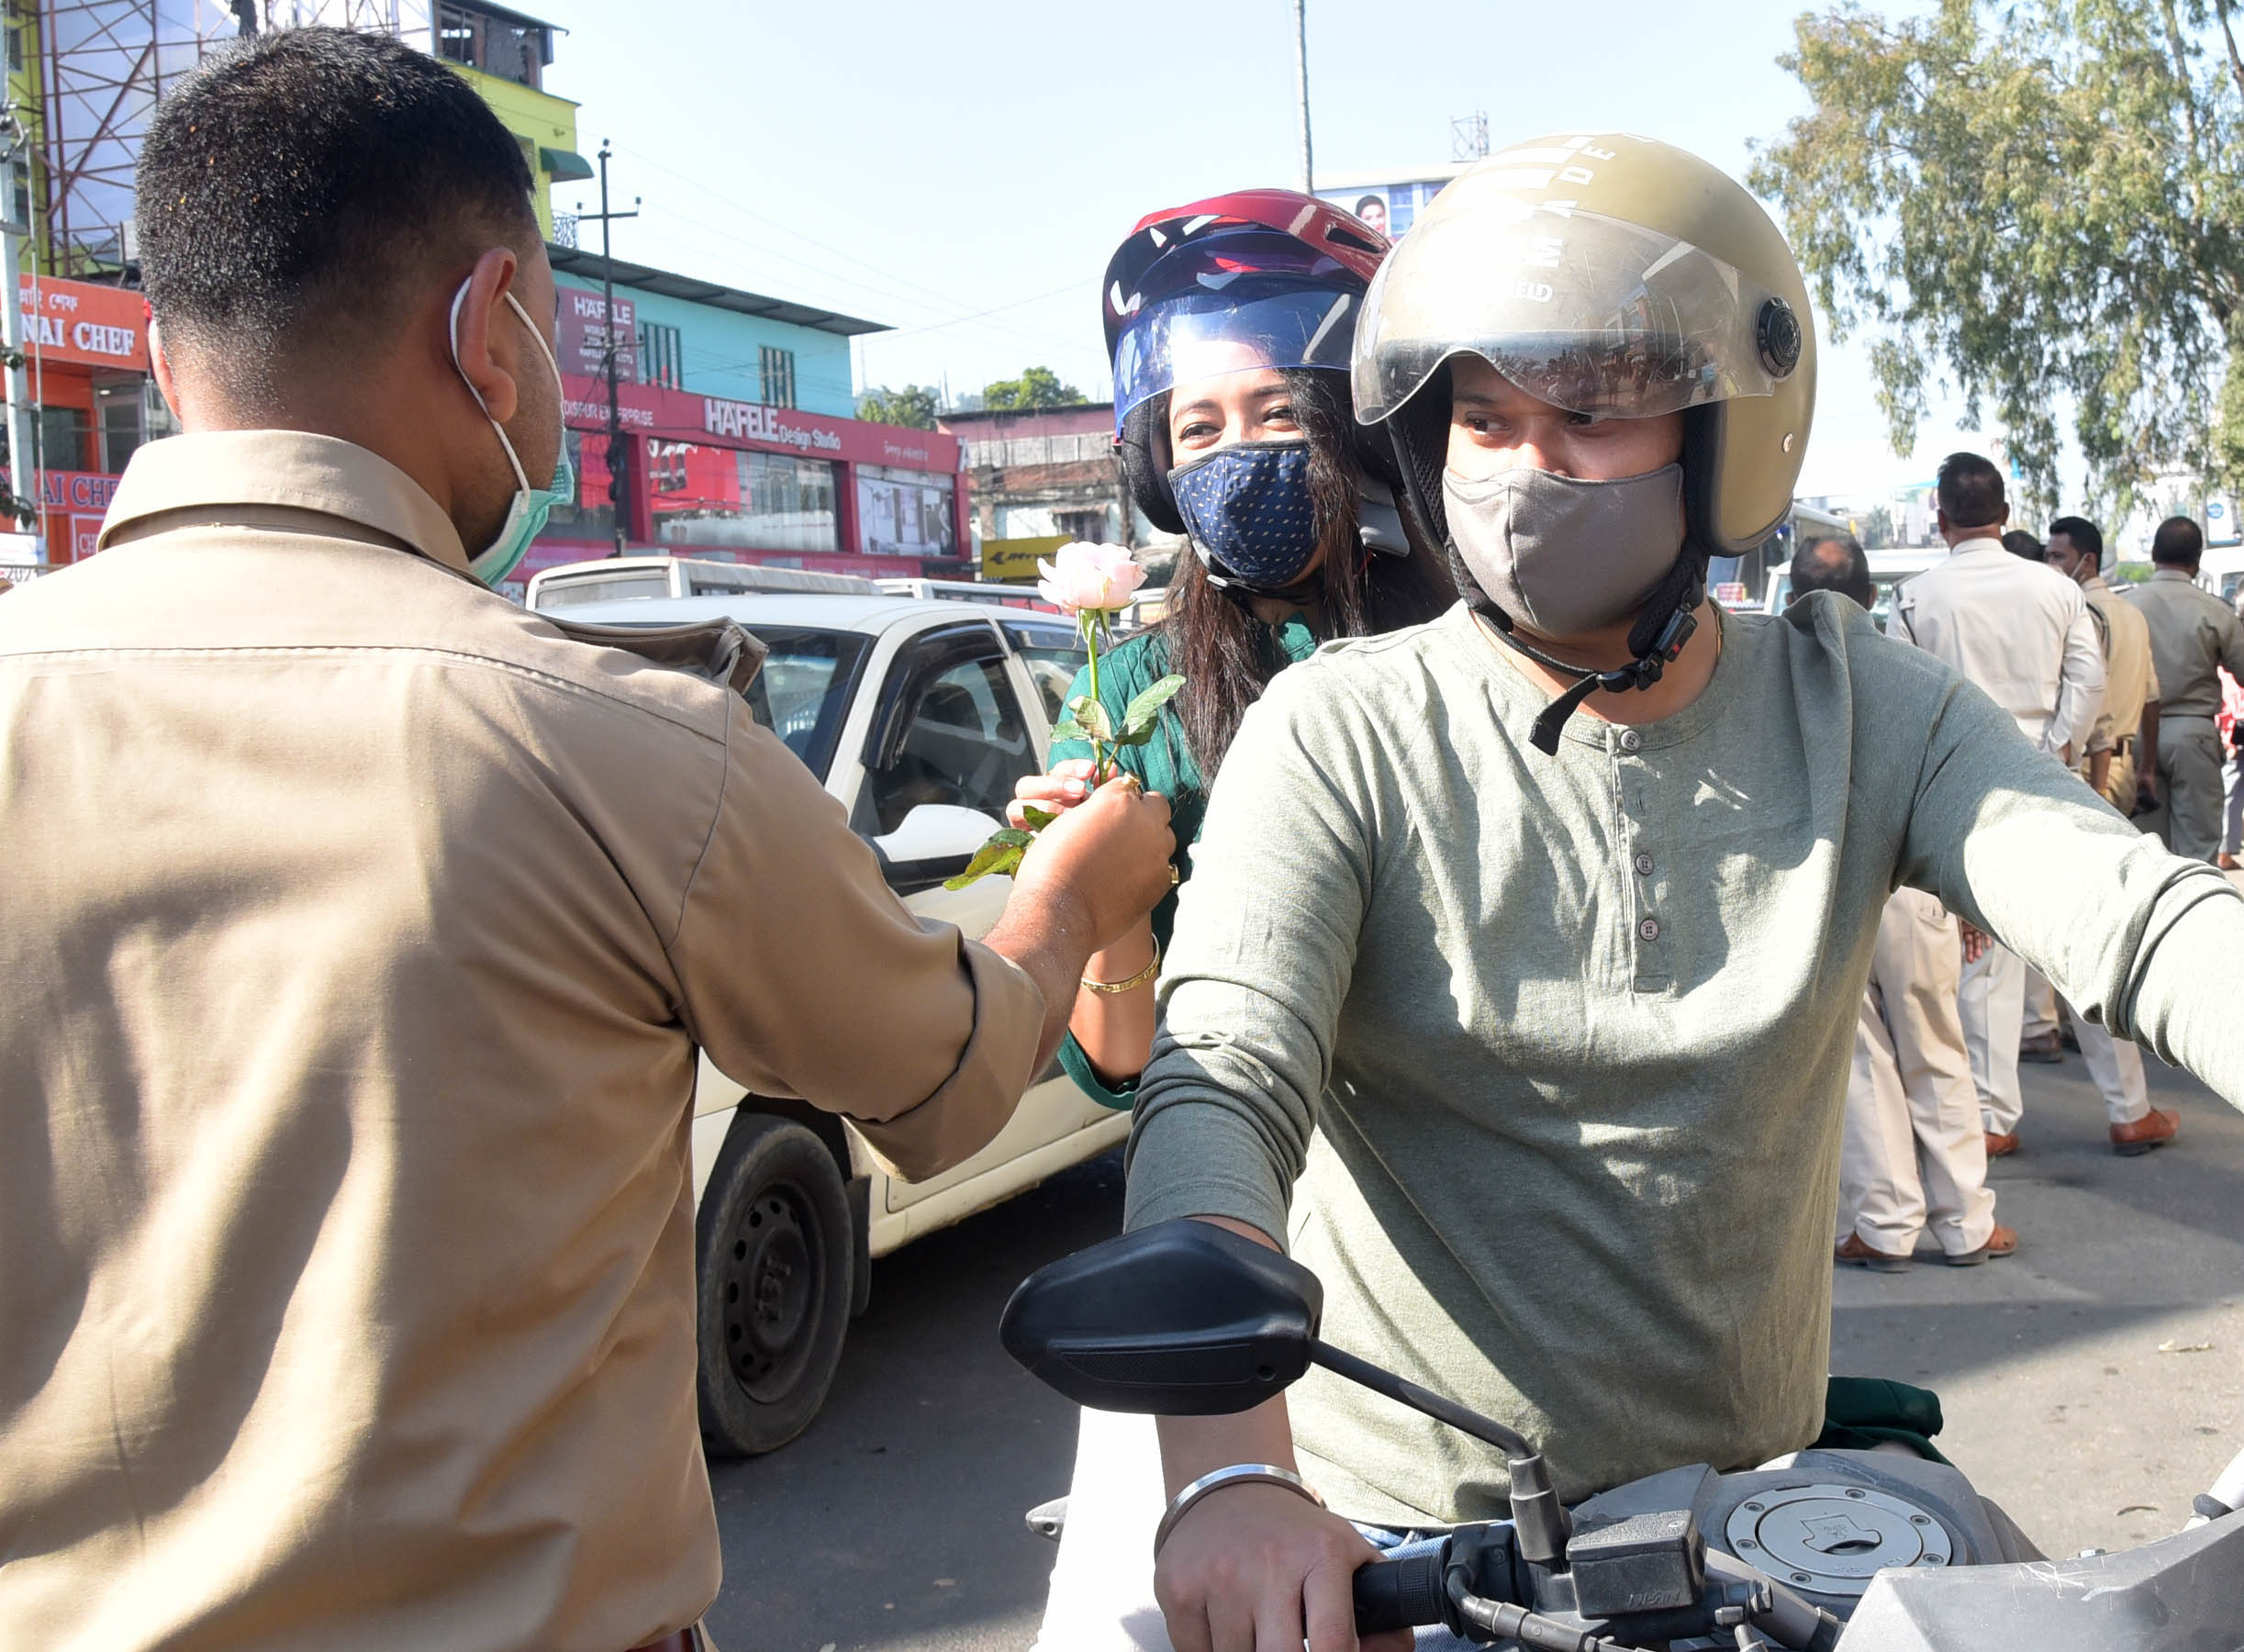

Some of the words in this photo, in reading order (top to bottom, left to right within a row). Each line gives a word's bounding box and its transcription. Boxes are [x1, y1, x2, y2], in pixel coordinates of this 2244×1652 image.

[574, 296, 631, 325] HÄFLE
[73, 321, 135, 356] CHEF
[598, 405, 653, 427] ENERPRISE
[780, 424, 811, 451] Design
[811, 429, 842, 451] Studio
